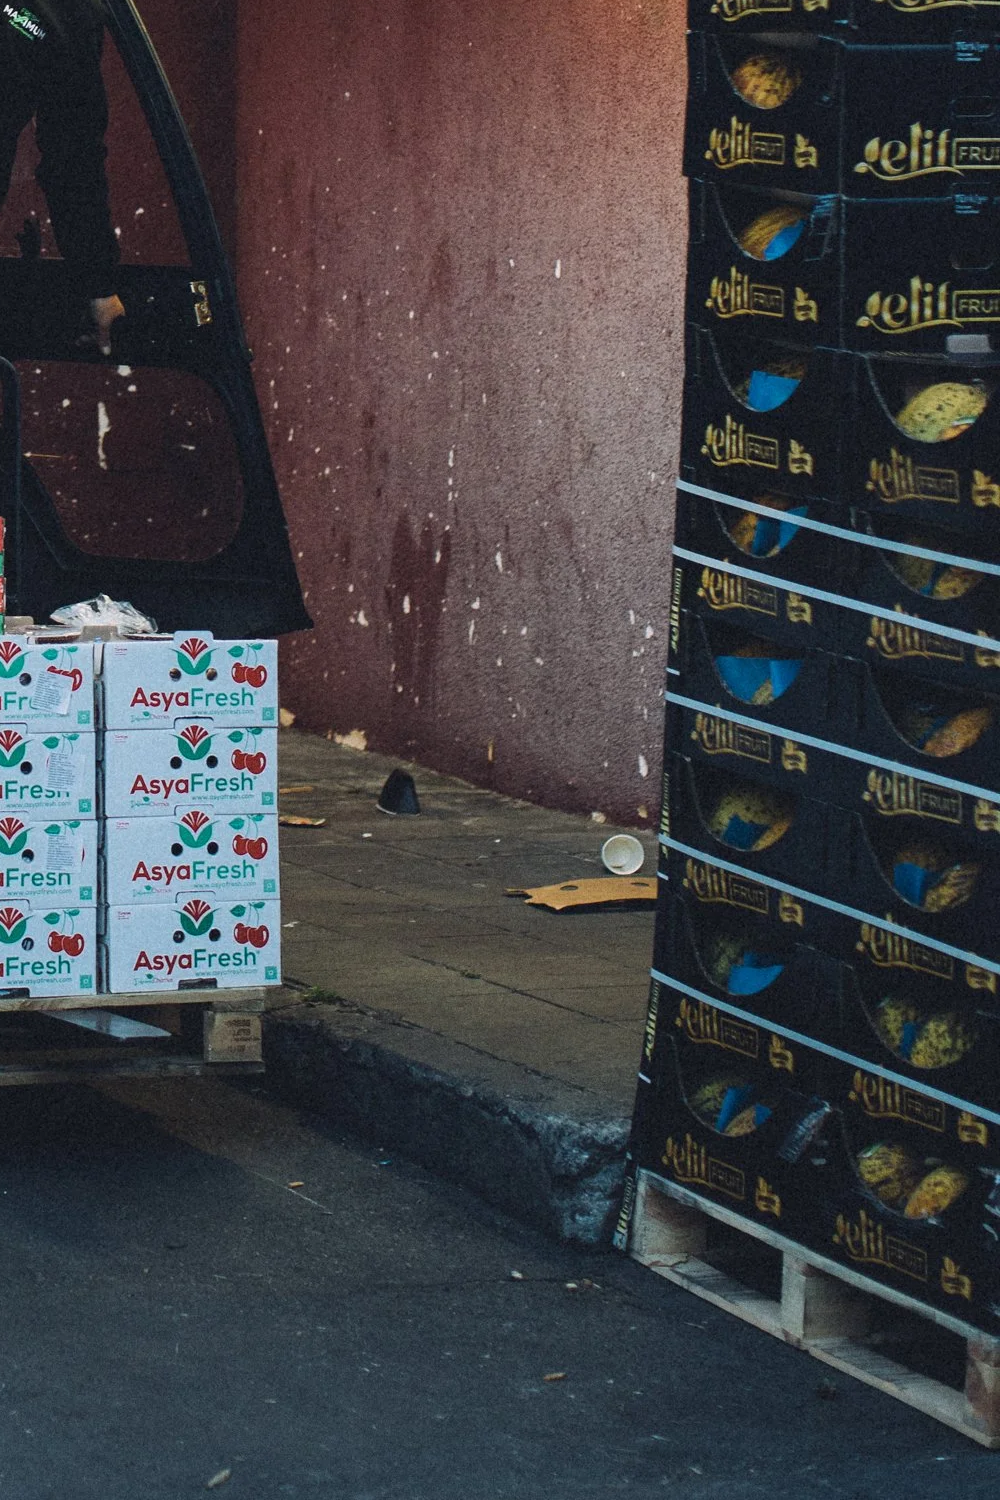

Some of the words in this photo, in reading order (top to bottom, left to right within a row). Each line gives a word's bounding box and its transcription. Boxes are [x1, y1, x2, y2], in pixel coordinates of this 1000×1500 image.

[130, 688, 255, 712] AsyaFresh
[130, 772, 254, 800] AsyaFresh
[132, 860, 256, 886] AsyaFresh
[134, 948, 257, 975] AsyaFresh
